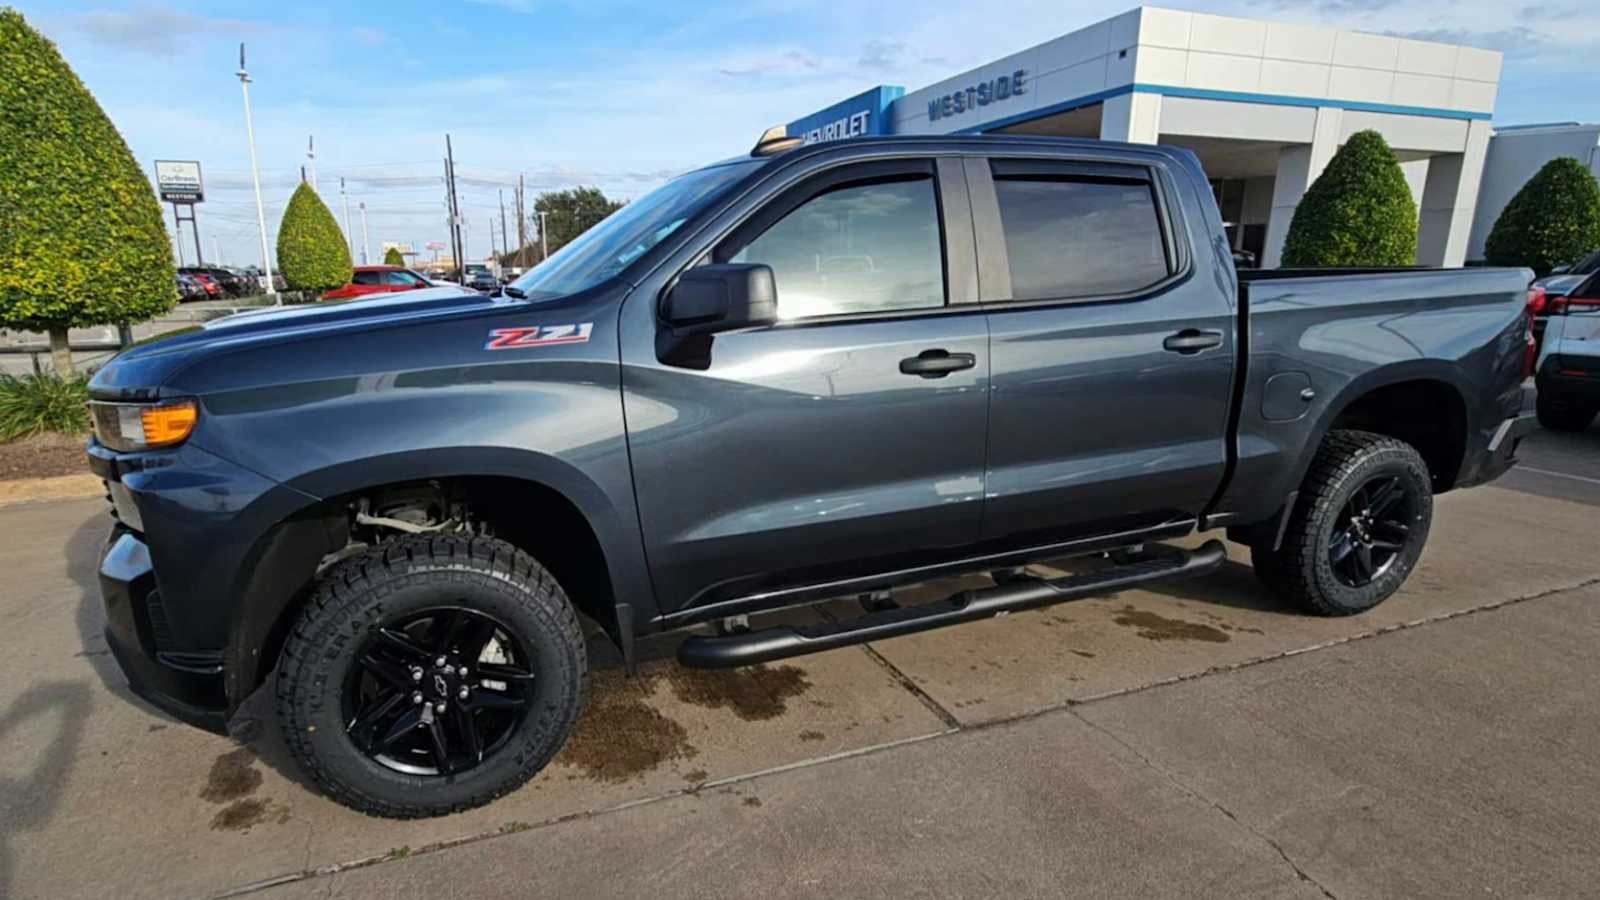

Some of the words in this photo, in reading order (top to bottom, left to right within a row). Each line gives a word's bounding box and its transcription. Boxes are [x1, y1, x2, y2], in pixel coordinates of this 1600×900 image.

[928, 68, 1026, 121] WESTSIDE
[801, 110, 870, 144] HEVROLET
[484, 322, 594, 351] Z71
